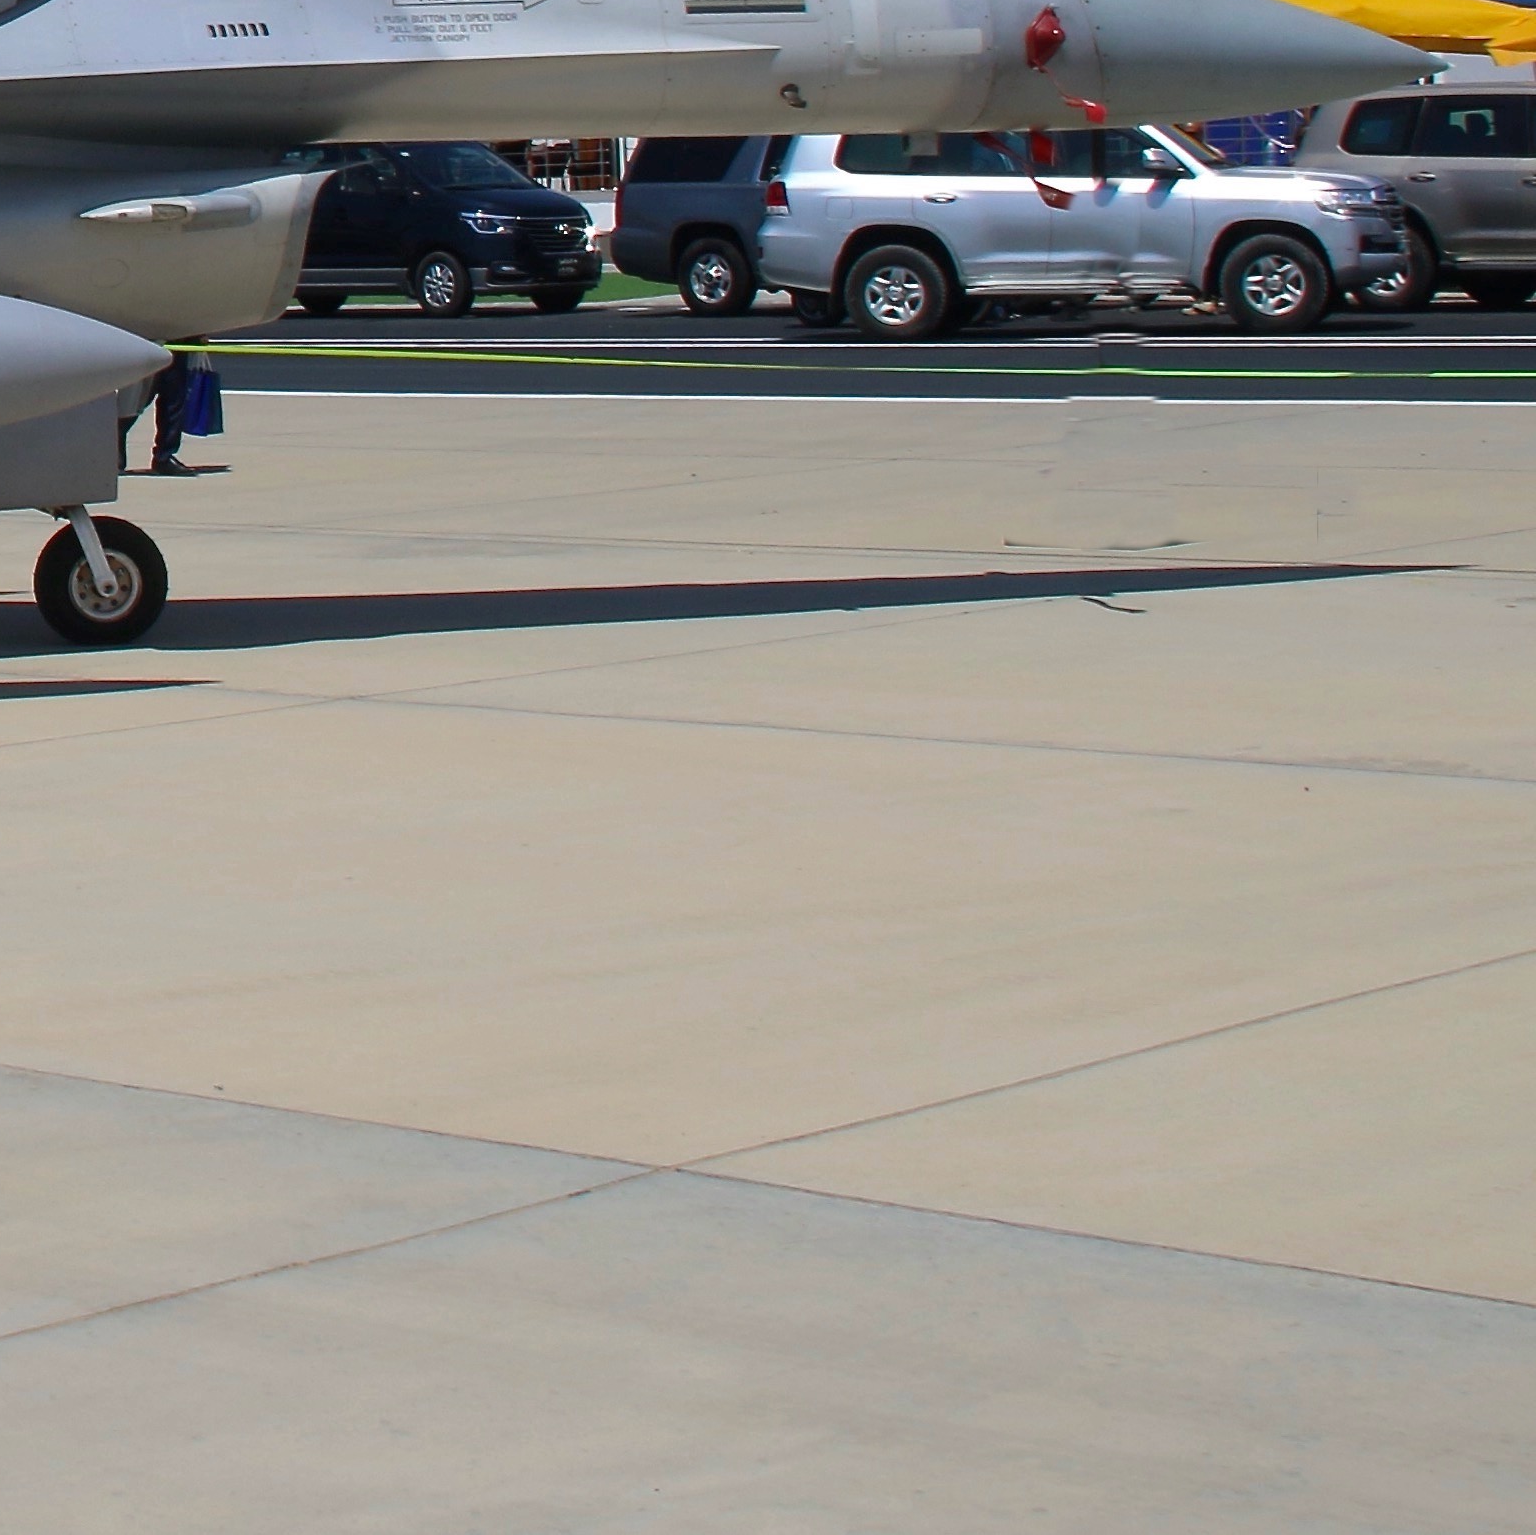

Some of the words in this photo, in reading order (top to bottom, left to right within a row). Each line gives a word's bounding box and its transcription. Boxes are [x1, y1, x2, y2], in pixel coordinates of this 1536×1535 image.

[383, 15, 408, 24] PUSH
[411, 15, 447, 23] BUTTON
[450, 14, 462, 22] TO
[465, 14, 489, 22] OPEN
[493, 13, 518, 22] DOOR
[387, 25, 411, 33] PULL
[438, 24, 456, 32] OUT
[470, 23, 493, 32] FEET
[436, 34, 471, 42] CANOPY
